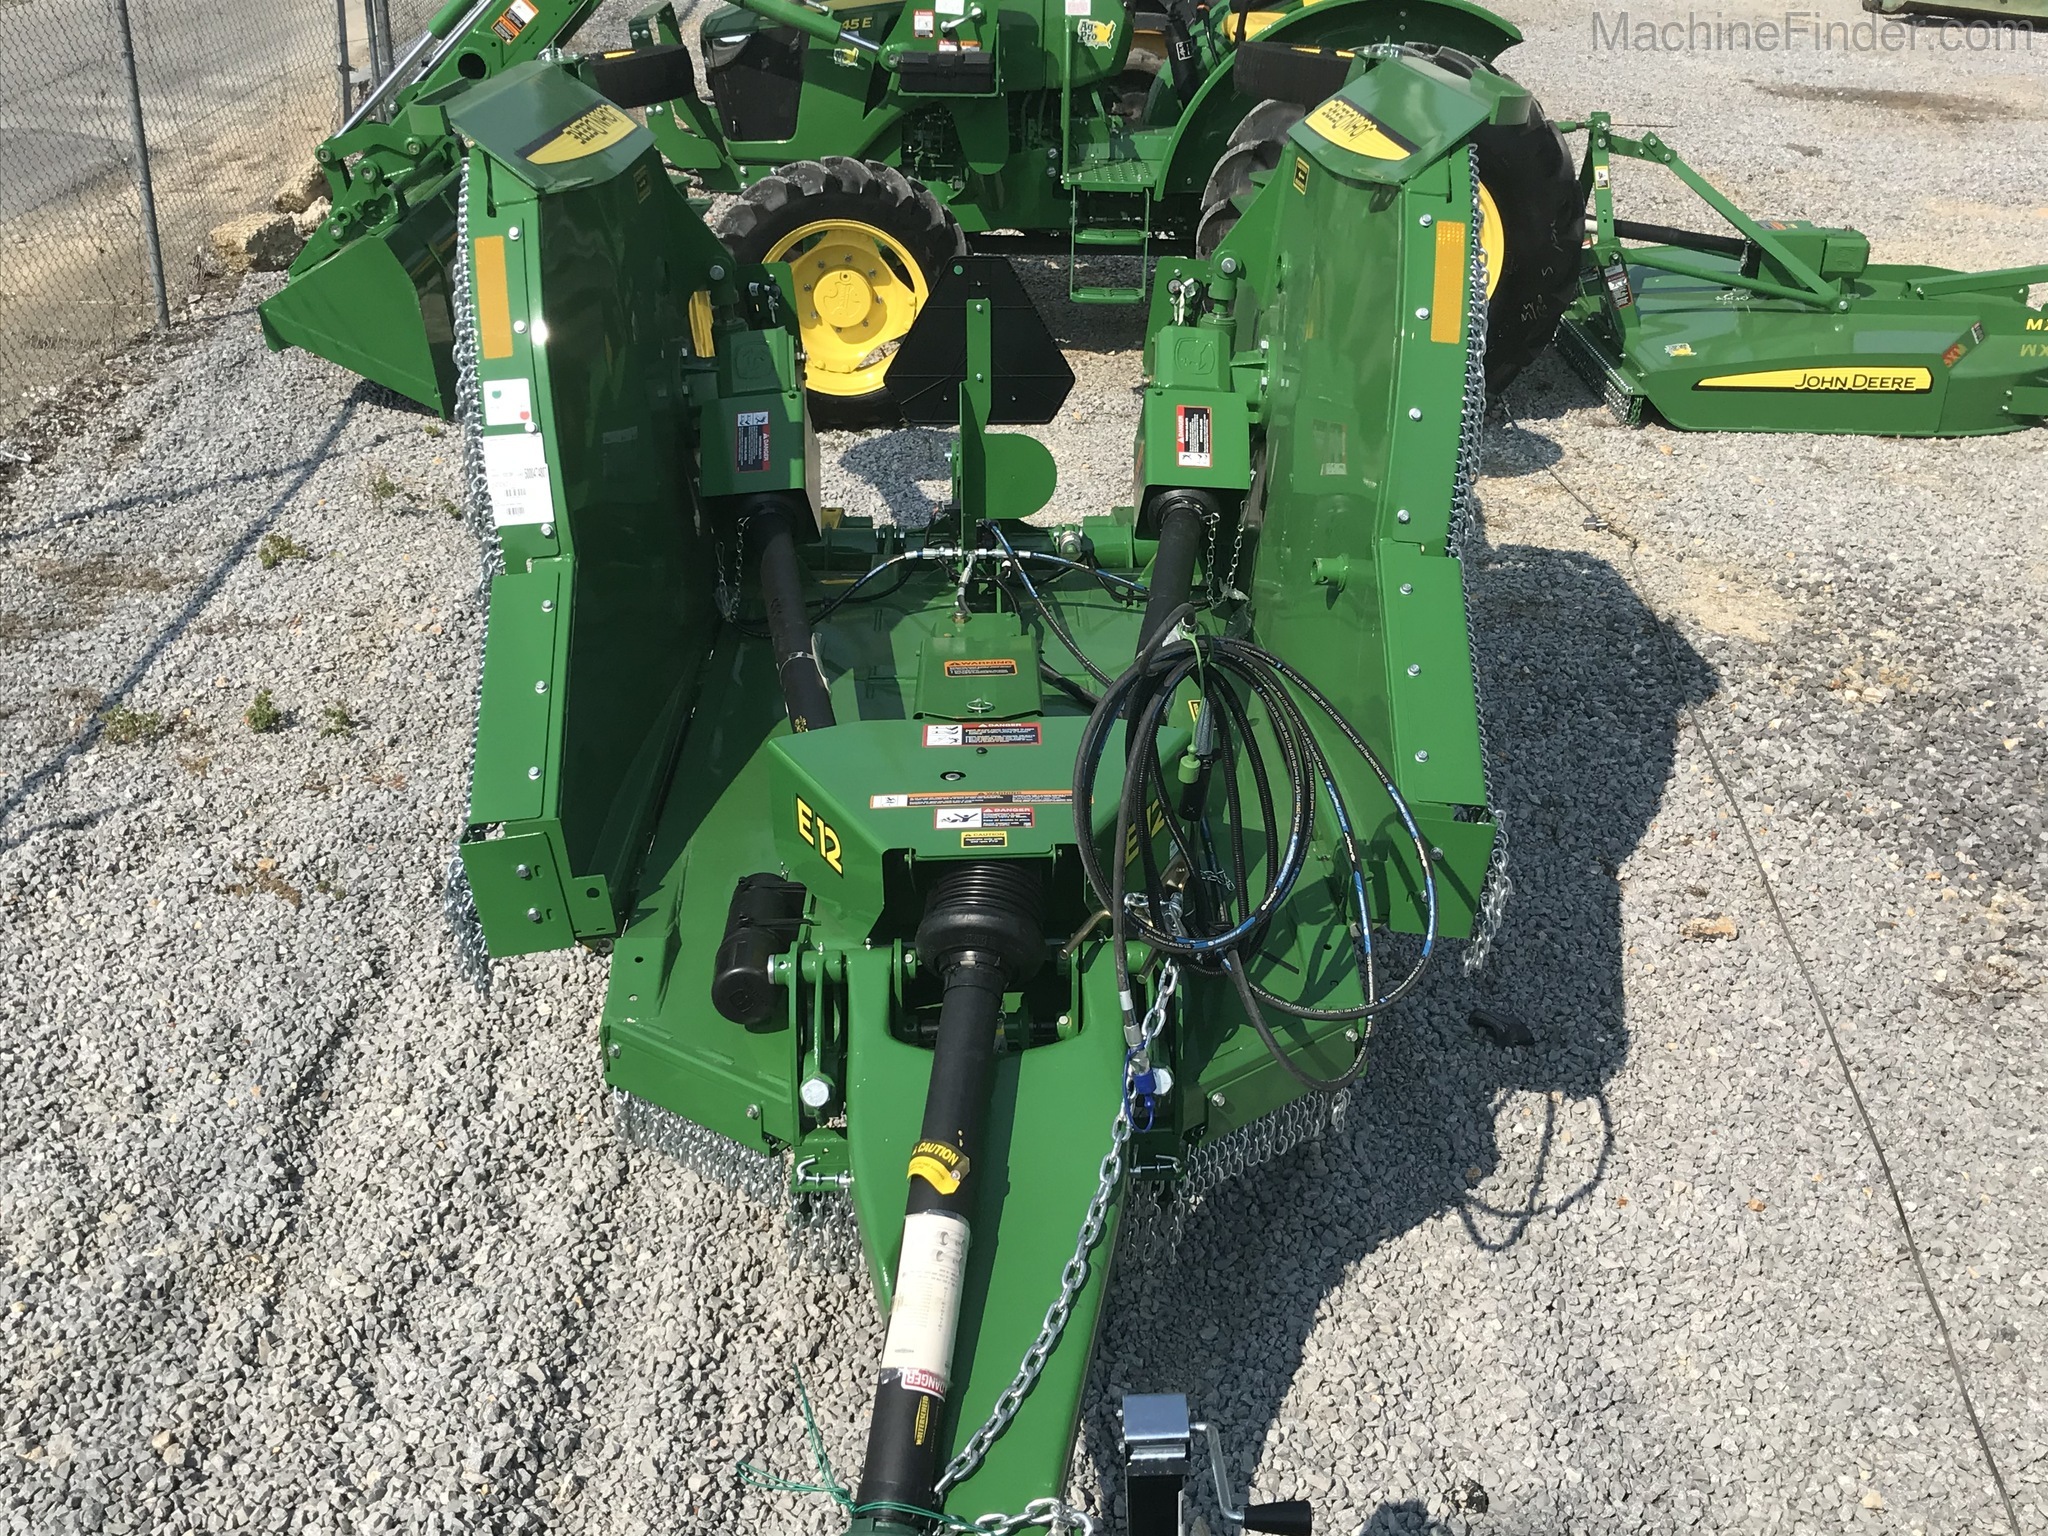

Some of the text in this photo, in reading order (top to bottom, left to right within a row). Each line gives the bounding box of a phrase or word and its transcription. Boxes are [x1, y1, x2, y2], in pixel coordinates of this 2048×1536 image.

[1795, 373, 1917, 389] JOHN DEERE
[796, 795, 843, 875] E12
[917, 1141, 959, 1166] CAUTION
[906, 1371, 945, 1394] DANGER
